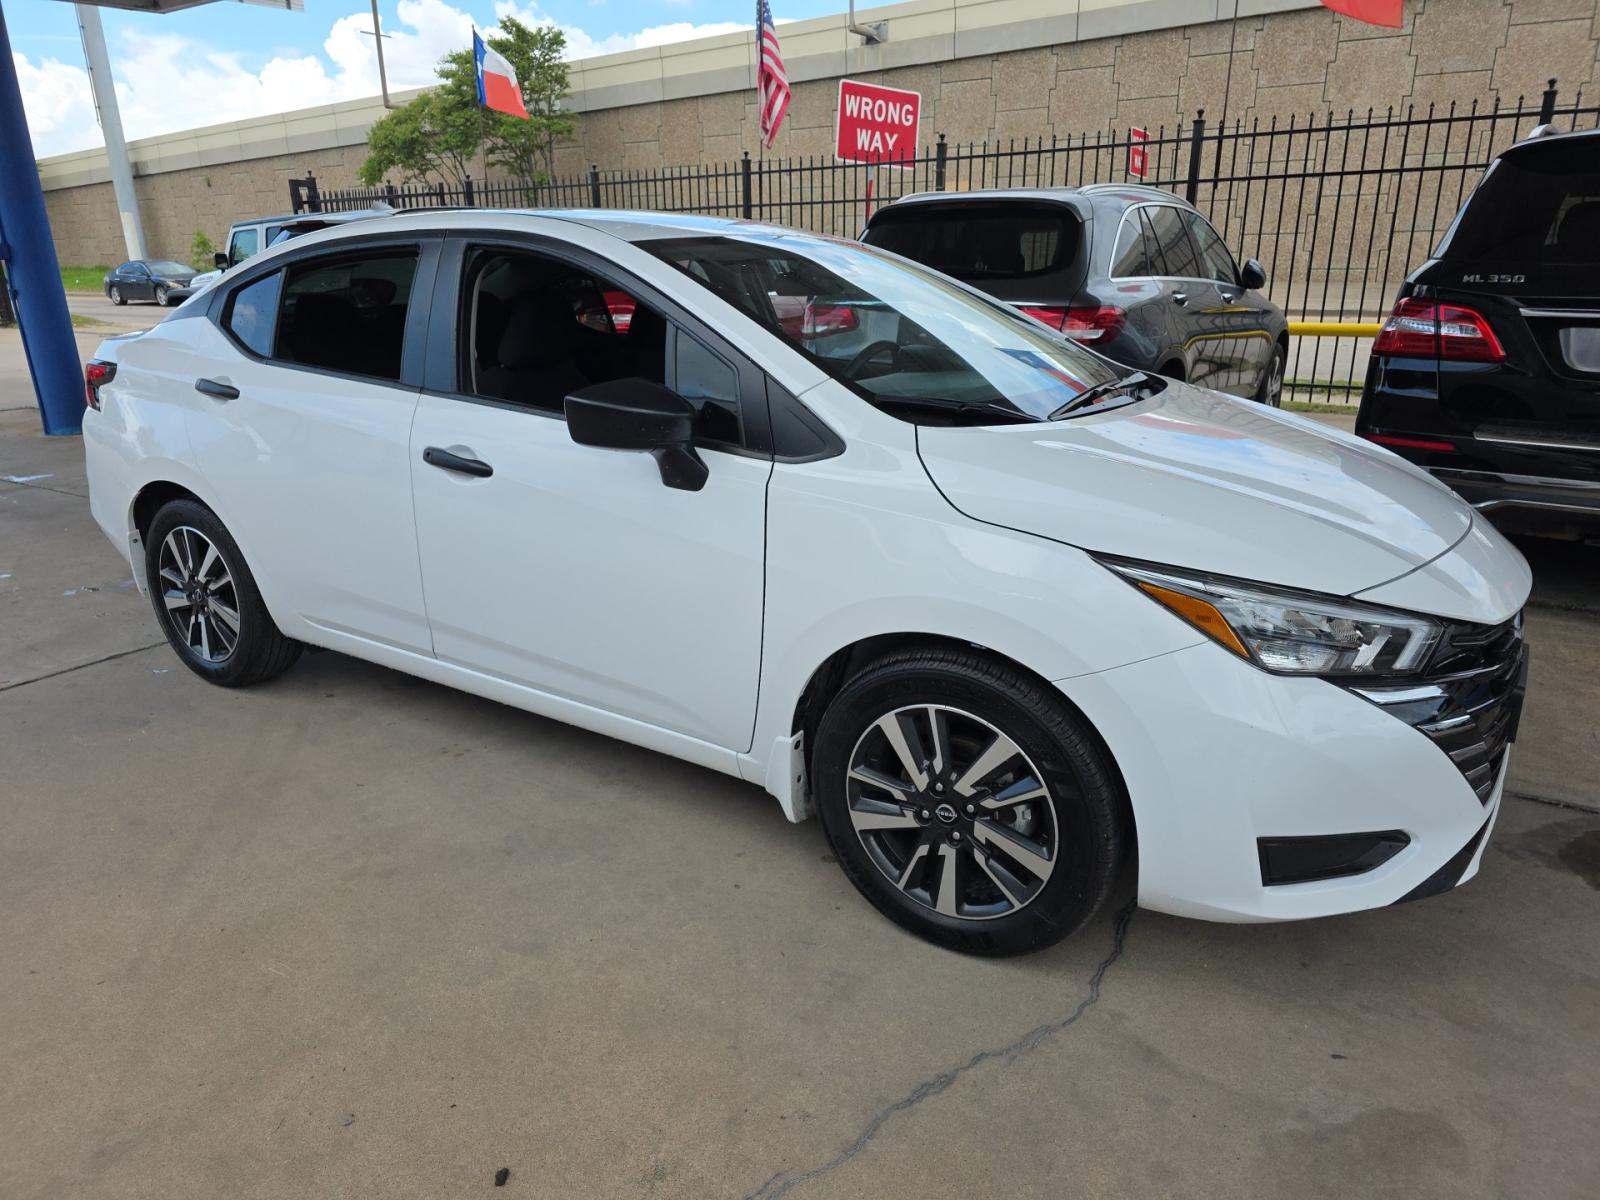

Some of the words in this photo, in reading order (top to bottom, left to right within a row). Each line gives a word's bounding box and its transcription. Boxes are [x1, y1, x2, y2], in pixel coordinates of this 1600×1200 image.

[845, 94, 914, 127] WRONG
[856, 128, 898, 153] WAY
[1462, 274, 1485, 283] ML
[1488, 274, 1526, 283] 350
